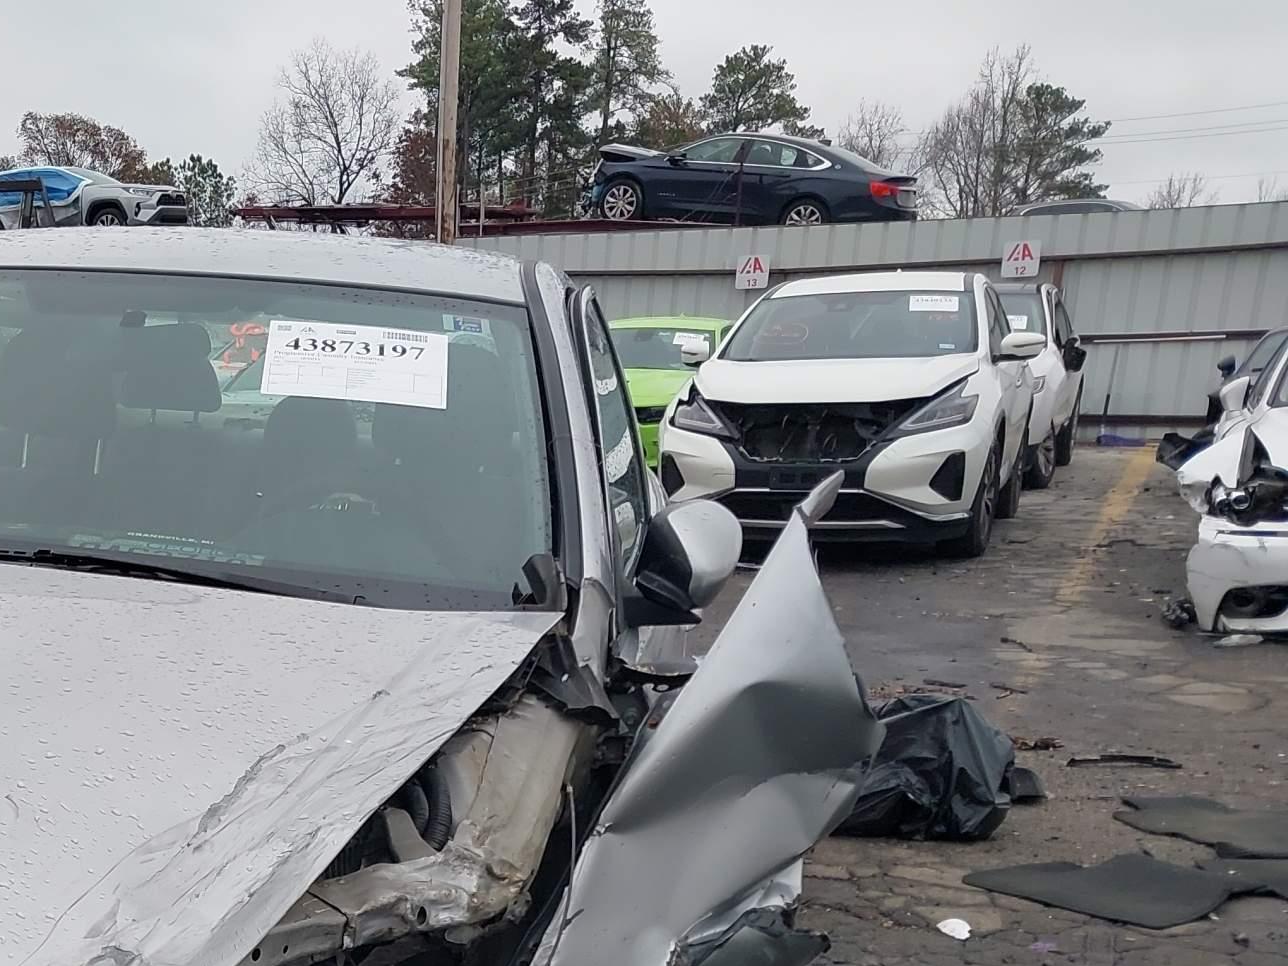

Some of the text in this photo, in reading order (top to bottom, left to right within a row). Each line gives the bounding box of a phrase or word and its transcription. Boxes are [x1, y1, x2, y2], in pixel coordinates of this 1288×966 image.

[1015, 266, 1026, 276] 12
[746, 278, 758, 287] 13
[285, 336, 426, 360] 43873197
